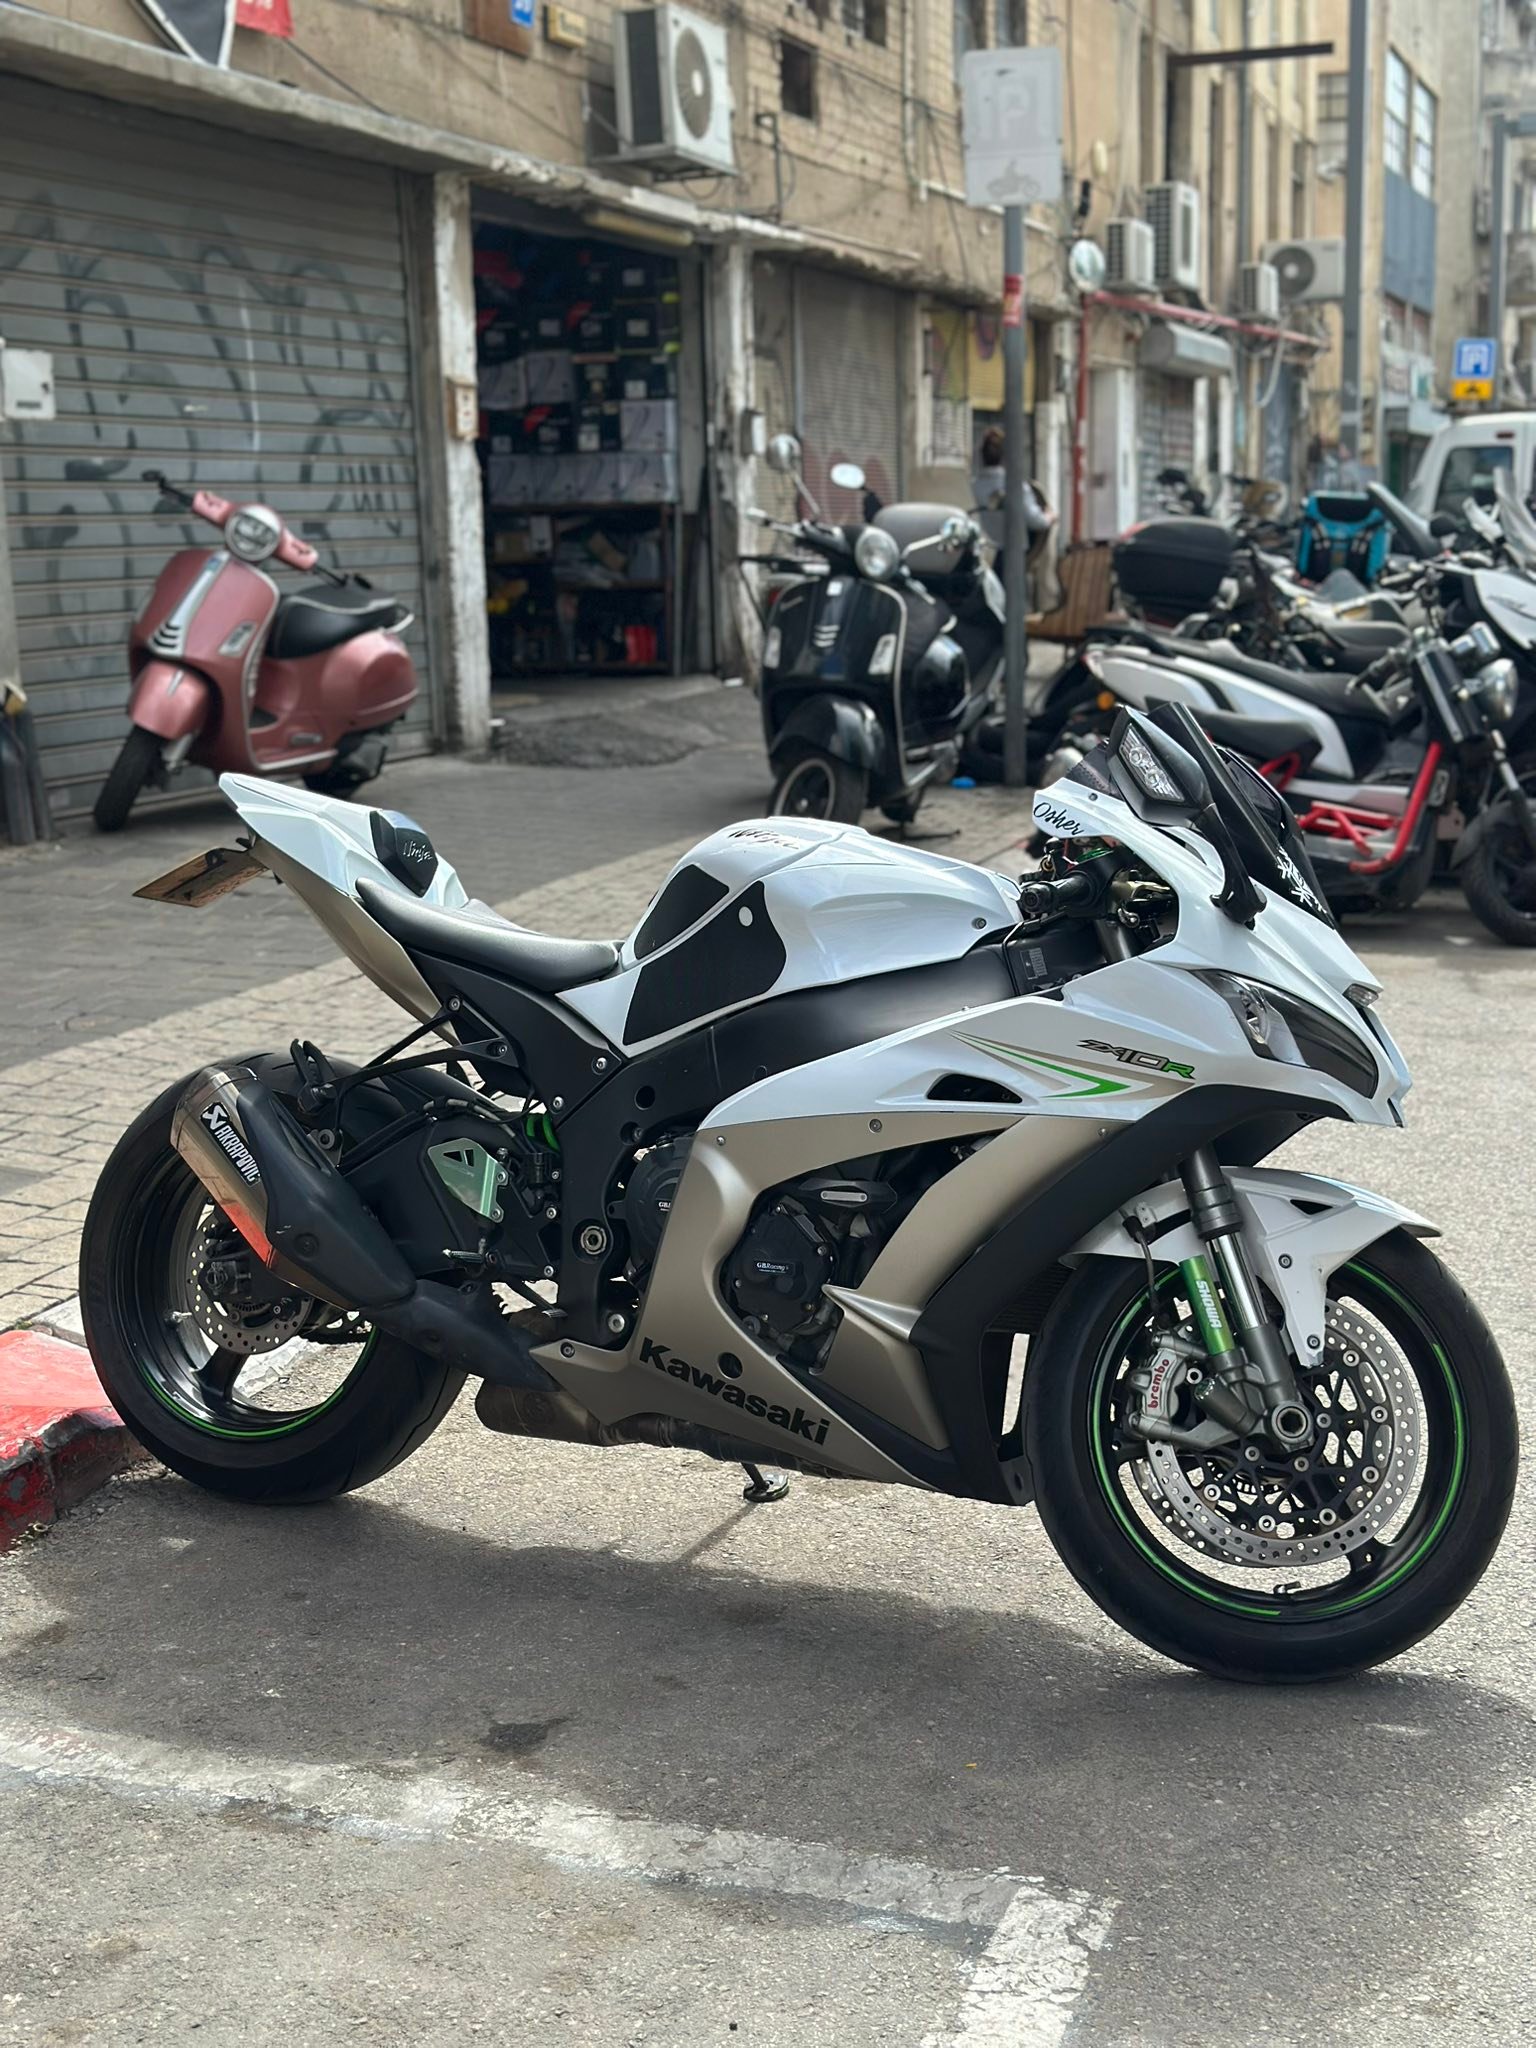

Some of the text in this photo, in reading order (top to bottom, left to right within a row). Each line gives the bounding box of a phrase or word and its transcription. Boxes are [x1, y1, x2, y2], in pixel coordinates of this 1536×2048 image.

[1033, 802, 1085, 835] Osher
[402, 841, 433, 863] Ninja
[1195, 1279, 1222, 1329] SHOWA
[638, 1336, 831, 1446] Kawasaki
[1147, 1358, 1170, 1409] brembo
